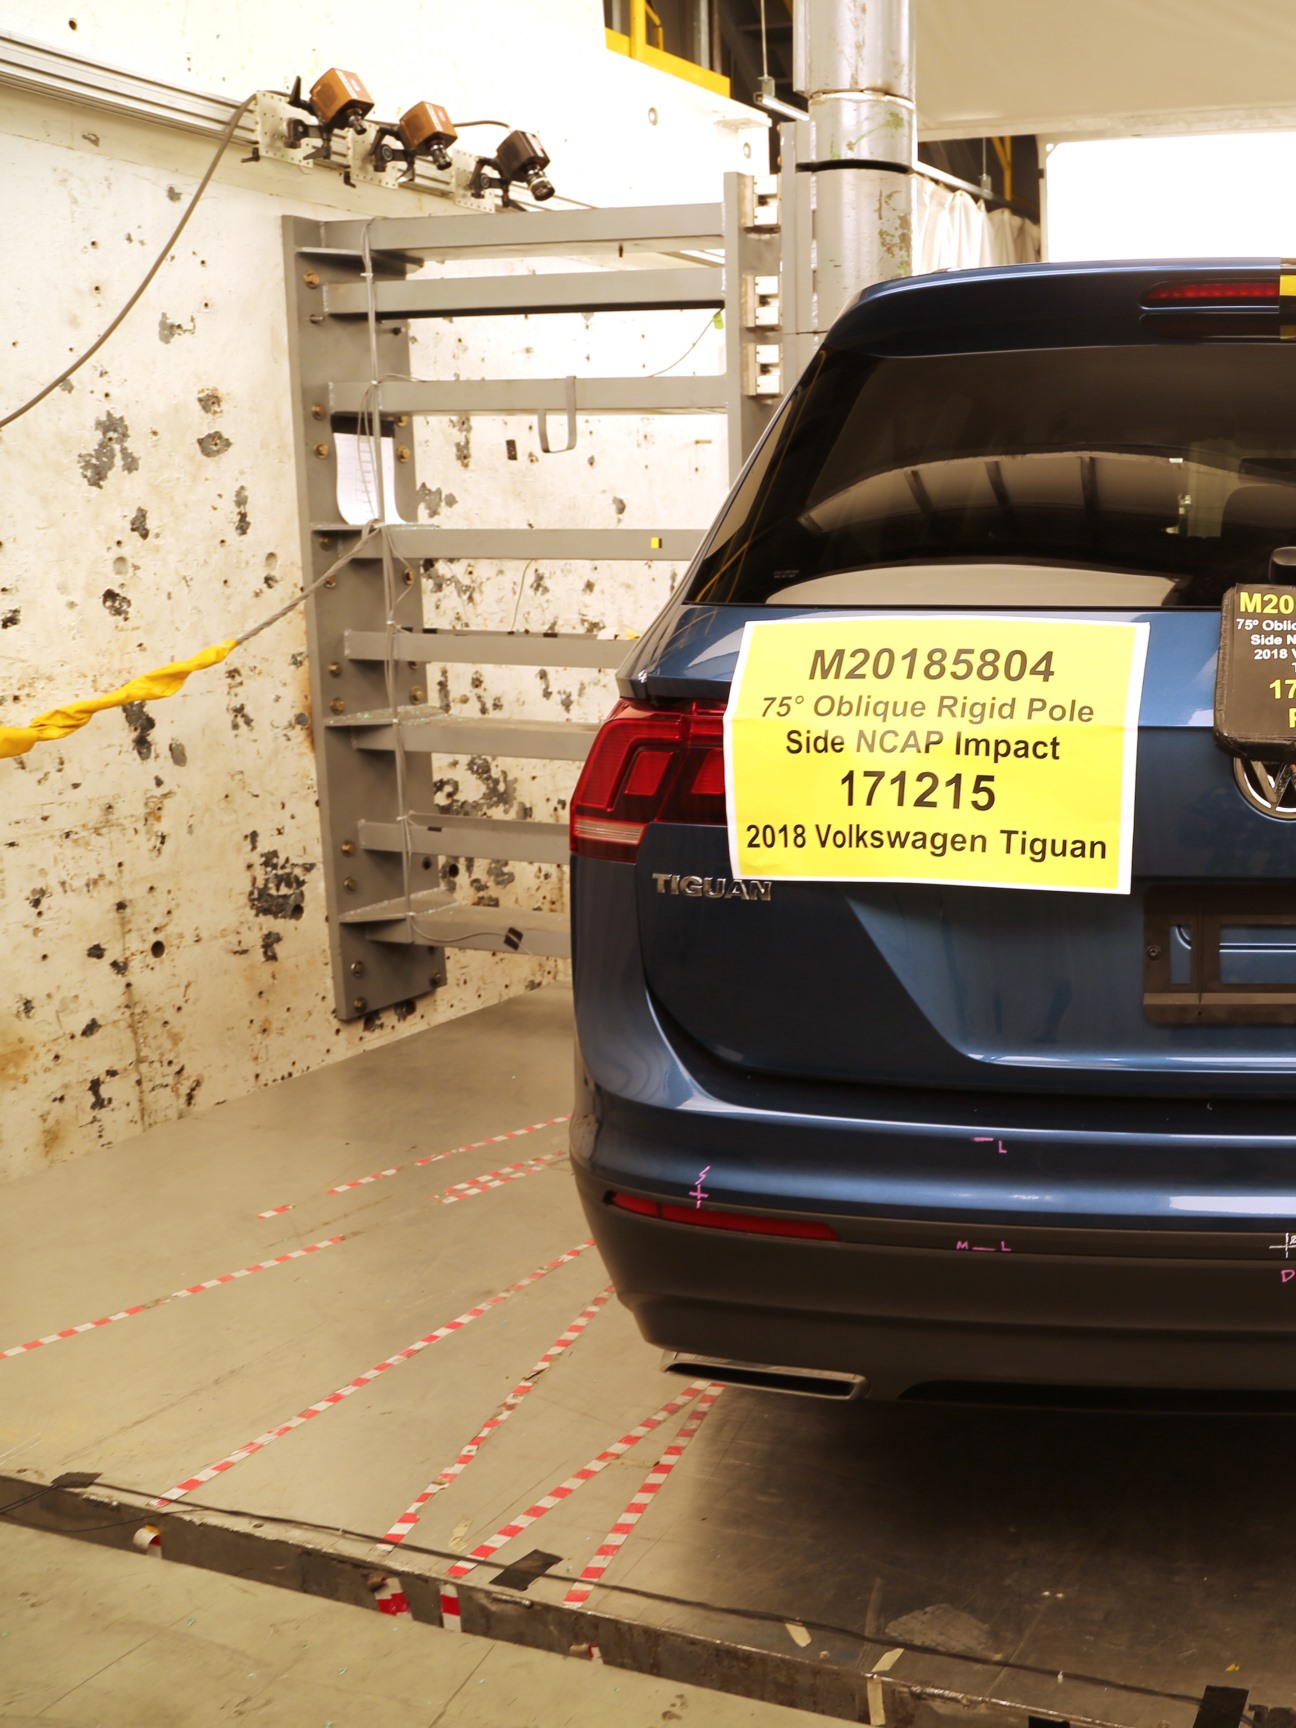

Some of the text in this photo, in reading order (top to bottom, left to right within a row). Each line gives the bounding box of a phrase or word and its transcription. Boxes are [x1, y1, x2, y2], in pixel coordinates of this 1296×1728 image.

[1250, 634, 1283, 646] Side
[1253, 649, 1288, 660] 2018
[809, 647, 1055, 683] M20185804
[813, 694, 926, 723] Oblique
[937, 695, 1016, 725] Rigid
[1026, 697, 1094, 723] Pole
[786, 729, 1061, 764] Side NCAP Impact
[840, 770, 996, 812] 171215
[746, 823, 1107, 863] 2018 Volkswagen Tiguan
[652, 873, 772, 901] TIGUAN
